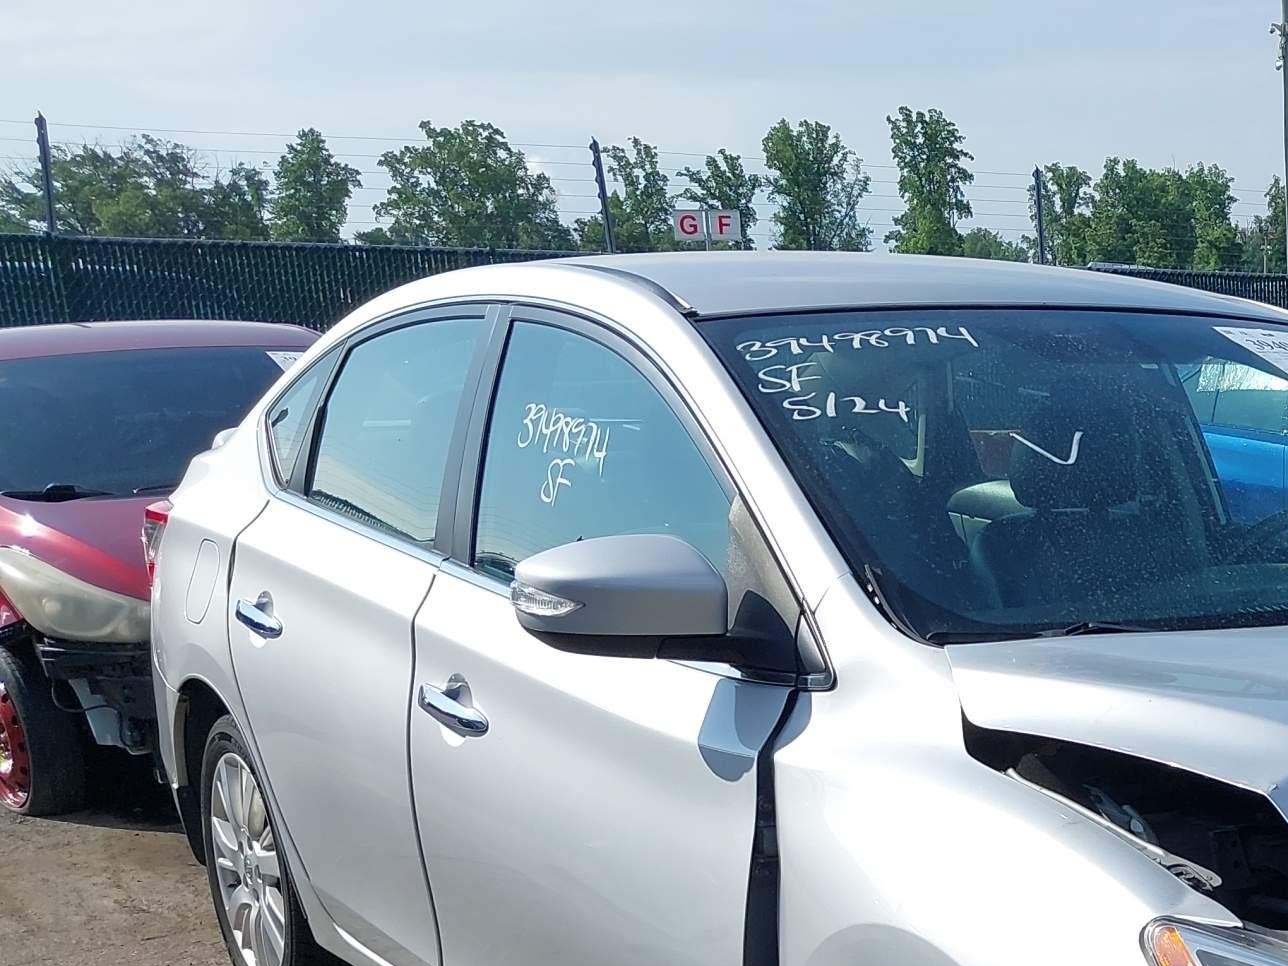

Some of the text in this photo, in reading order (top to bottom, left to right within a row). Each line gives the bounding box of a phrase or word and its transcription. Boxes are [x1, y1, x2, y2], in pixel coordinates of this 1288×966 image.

[679, 214, 698, 235] G
[718, 215, 731, 235] F
[735, 326, 979, 361] 39498974
[757, 362, 823, 393] SF
